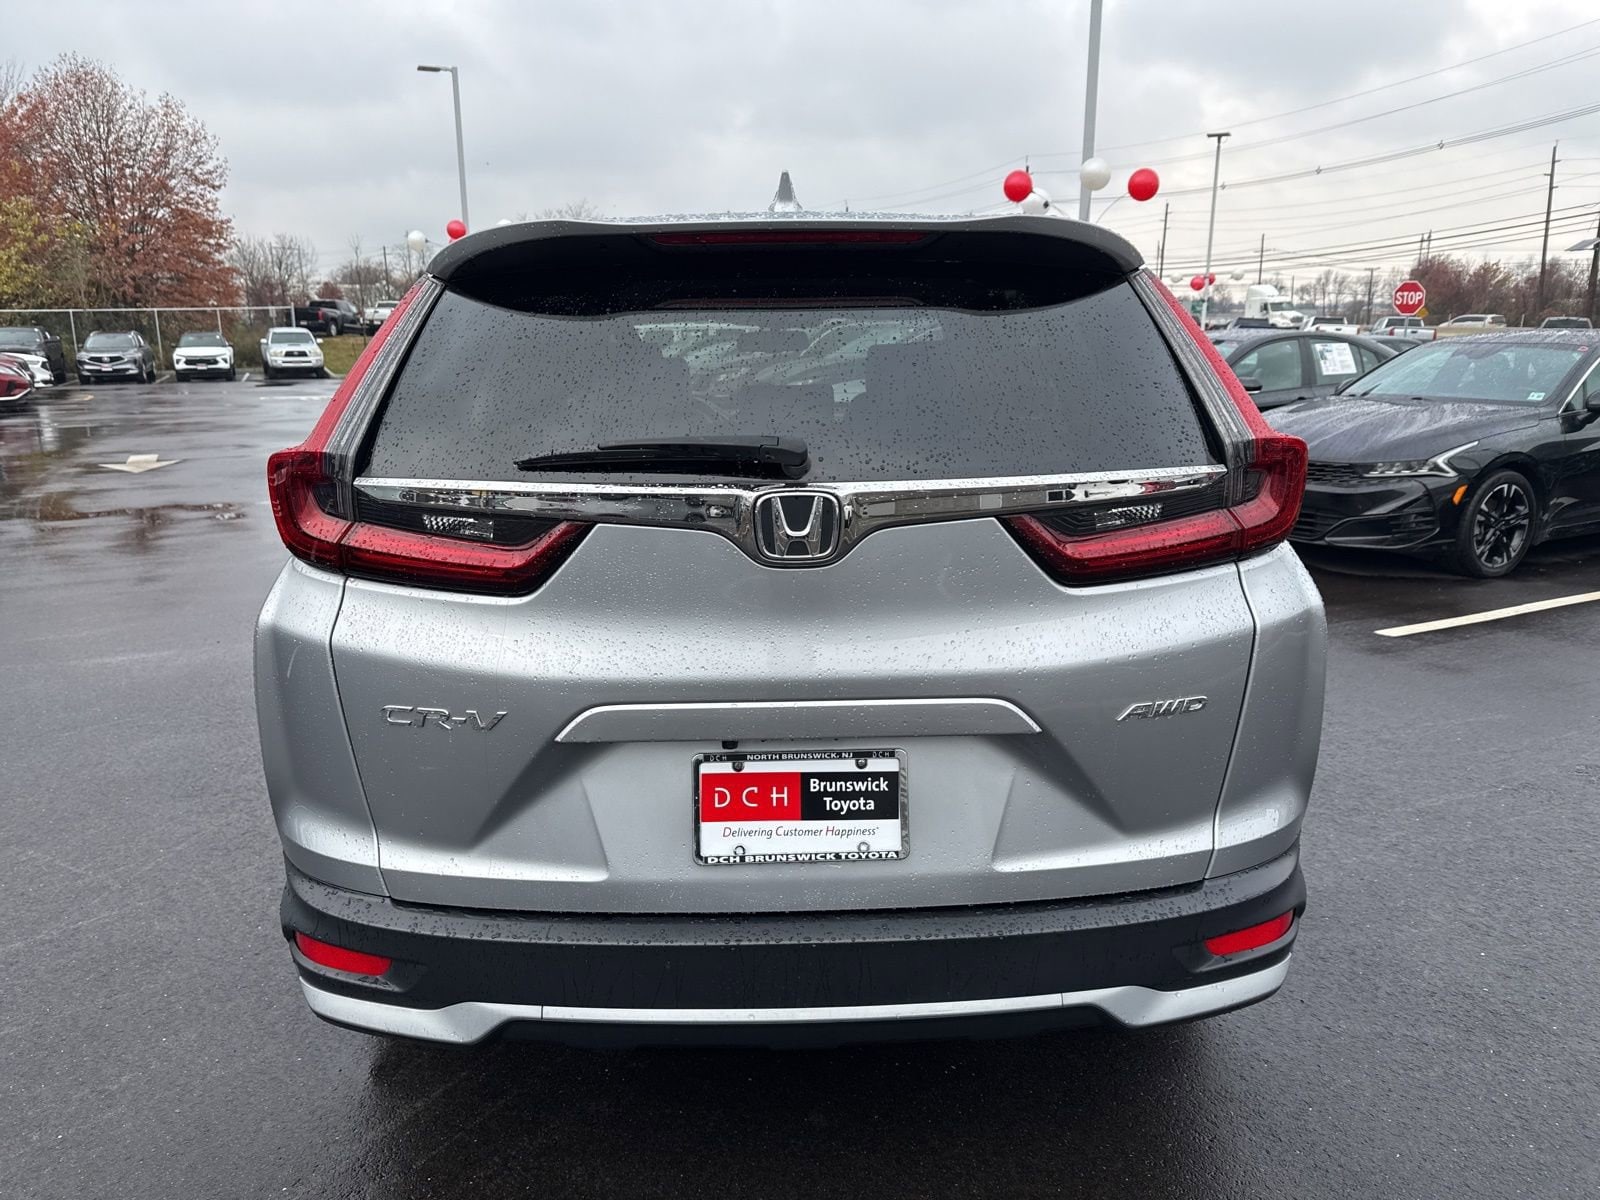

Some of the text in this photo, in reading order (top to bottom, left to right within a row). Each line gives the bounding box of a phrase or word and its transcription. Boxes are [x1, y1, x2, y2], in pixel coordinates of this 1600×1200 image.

[1395, 291, 1423, 305] STOP
[1115, 695, 1208, 721] AWD
[381, 704, 508, 731] CR-V
[746, 751, 854, 761] NORTH BRUNSWICK, NJ
[809, 777, 889, 792] Brunswick
[714, 786, 789, 808] DCH
[823, 796, 875, 815] Toyota
[722, 826, 773, 840] Delivering
[775, 825, 823, 837] Customer
[707, 850, 898, 864] DCH BRUNSWICK TOYOTA
